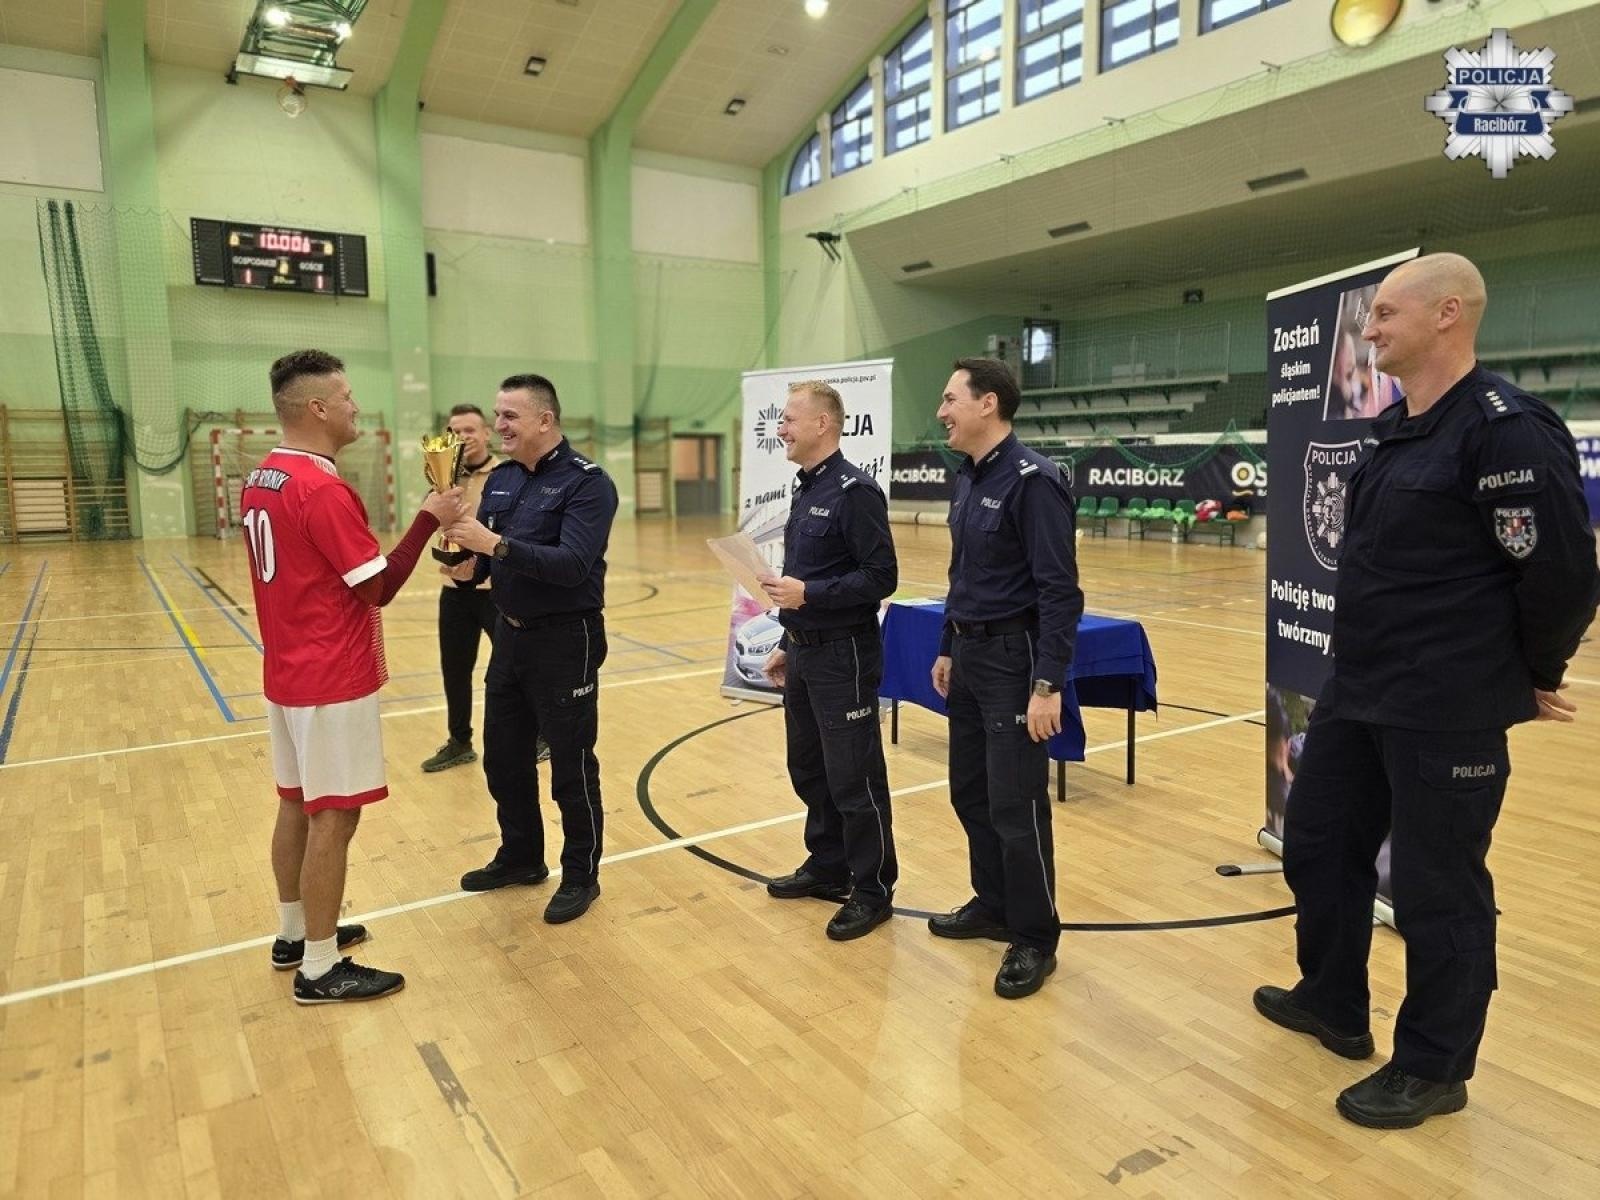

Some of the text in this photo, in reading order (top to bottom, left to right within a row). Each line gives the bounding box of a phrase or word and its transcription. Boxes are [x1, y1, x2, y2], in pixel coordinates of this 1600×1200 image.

[1273, 318, 1320, 353] Zostań
[1280, 360, 1311, 381] śląskim
[1271, 384, 1321, 408] policjantem!
[1311, 449, 1357, 466] POLICJA
[1088, 463, 1185, 487] RACIBÓRZ
[1478, 468, 1535, 491] POLICJA
[755, 483, 787, 505] nami
[243, 507, 276, 584] 10
[1271, 579, 1310, 612] Policję
[1277, 618, 1331, 656] twórzmy
[845, 705, 872, 722] POLICJA
[1451, 763, 1497, 779] POLICJA
